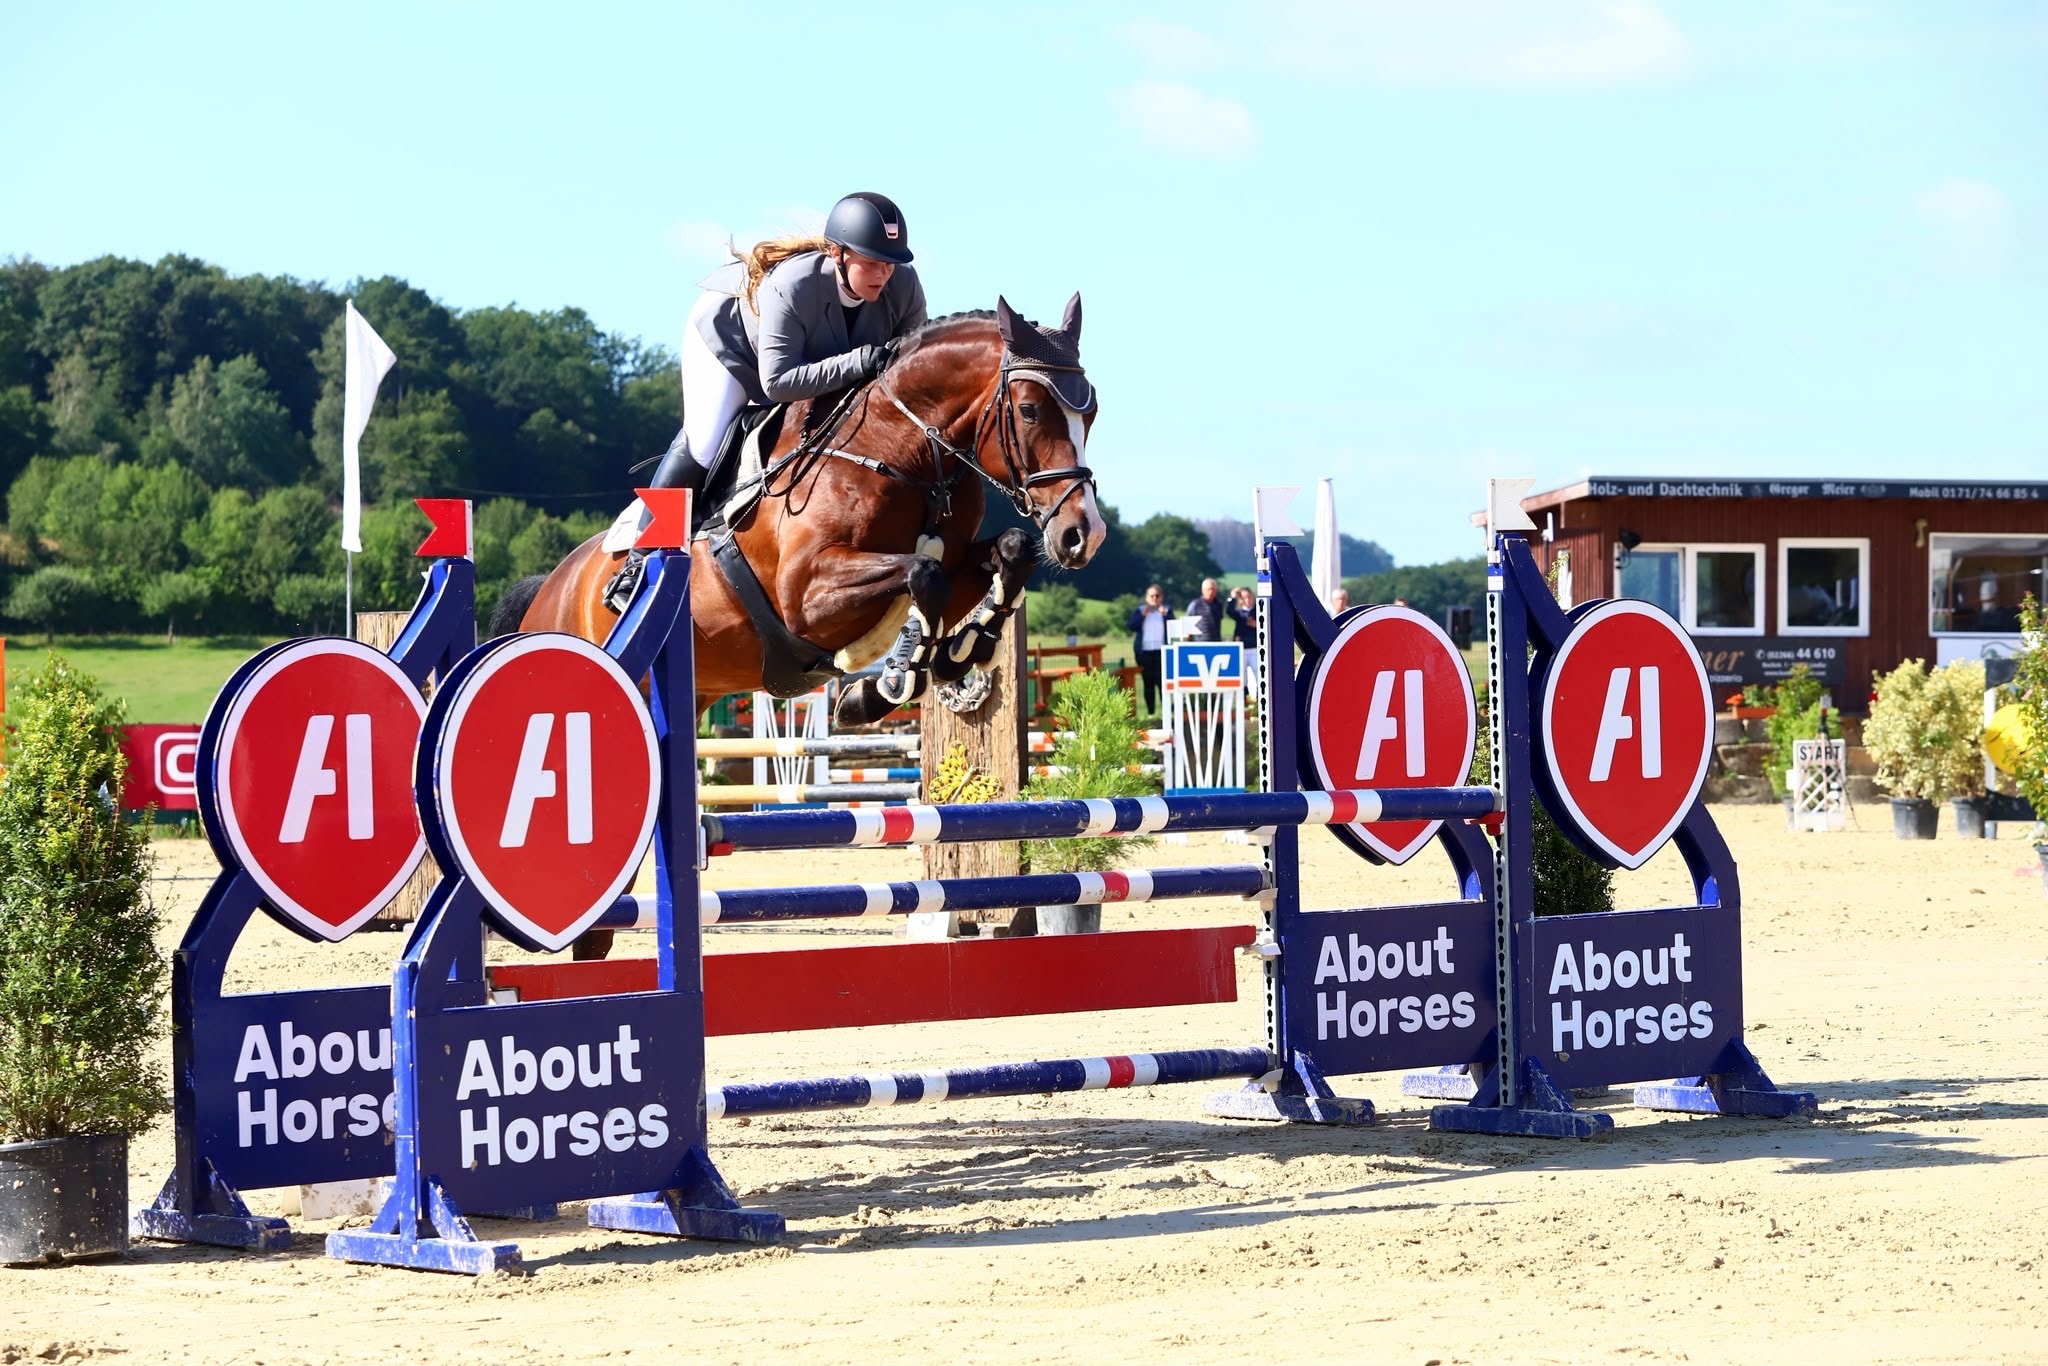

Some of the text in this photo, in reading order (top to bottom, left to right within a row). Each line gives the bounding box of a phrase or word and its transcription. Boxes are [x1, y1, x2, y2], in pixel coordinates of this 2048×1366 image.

[1589, 482, 1623, 496] Holz-
[1628, 483, 1653, 497] und
[1660, 483, 1743, 497] Dachtechnik
[1909, 487, 1940, 498] Mobil
[1796, 647, 1812, 659] 44
[1813, 647, 1836, 660] 610
[1313, 926, 1455, 985] About
[1549, 933, 1692, 995] About
[1316, 990, 1476, 1041] Horses
[1551, 1000, 1714, 1052] Horses
[233, 1021, 392, 1083] Abou
[456, 1024, 642, 1101] About
[237, 1088, 396, 1148] Hors
[460, 1103, 670, 1169] Horses
